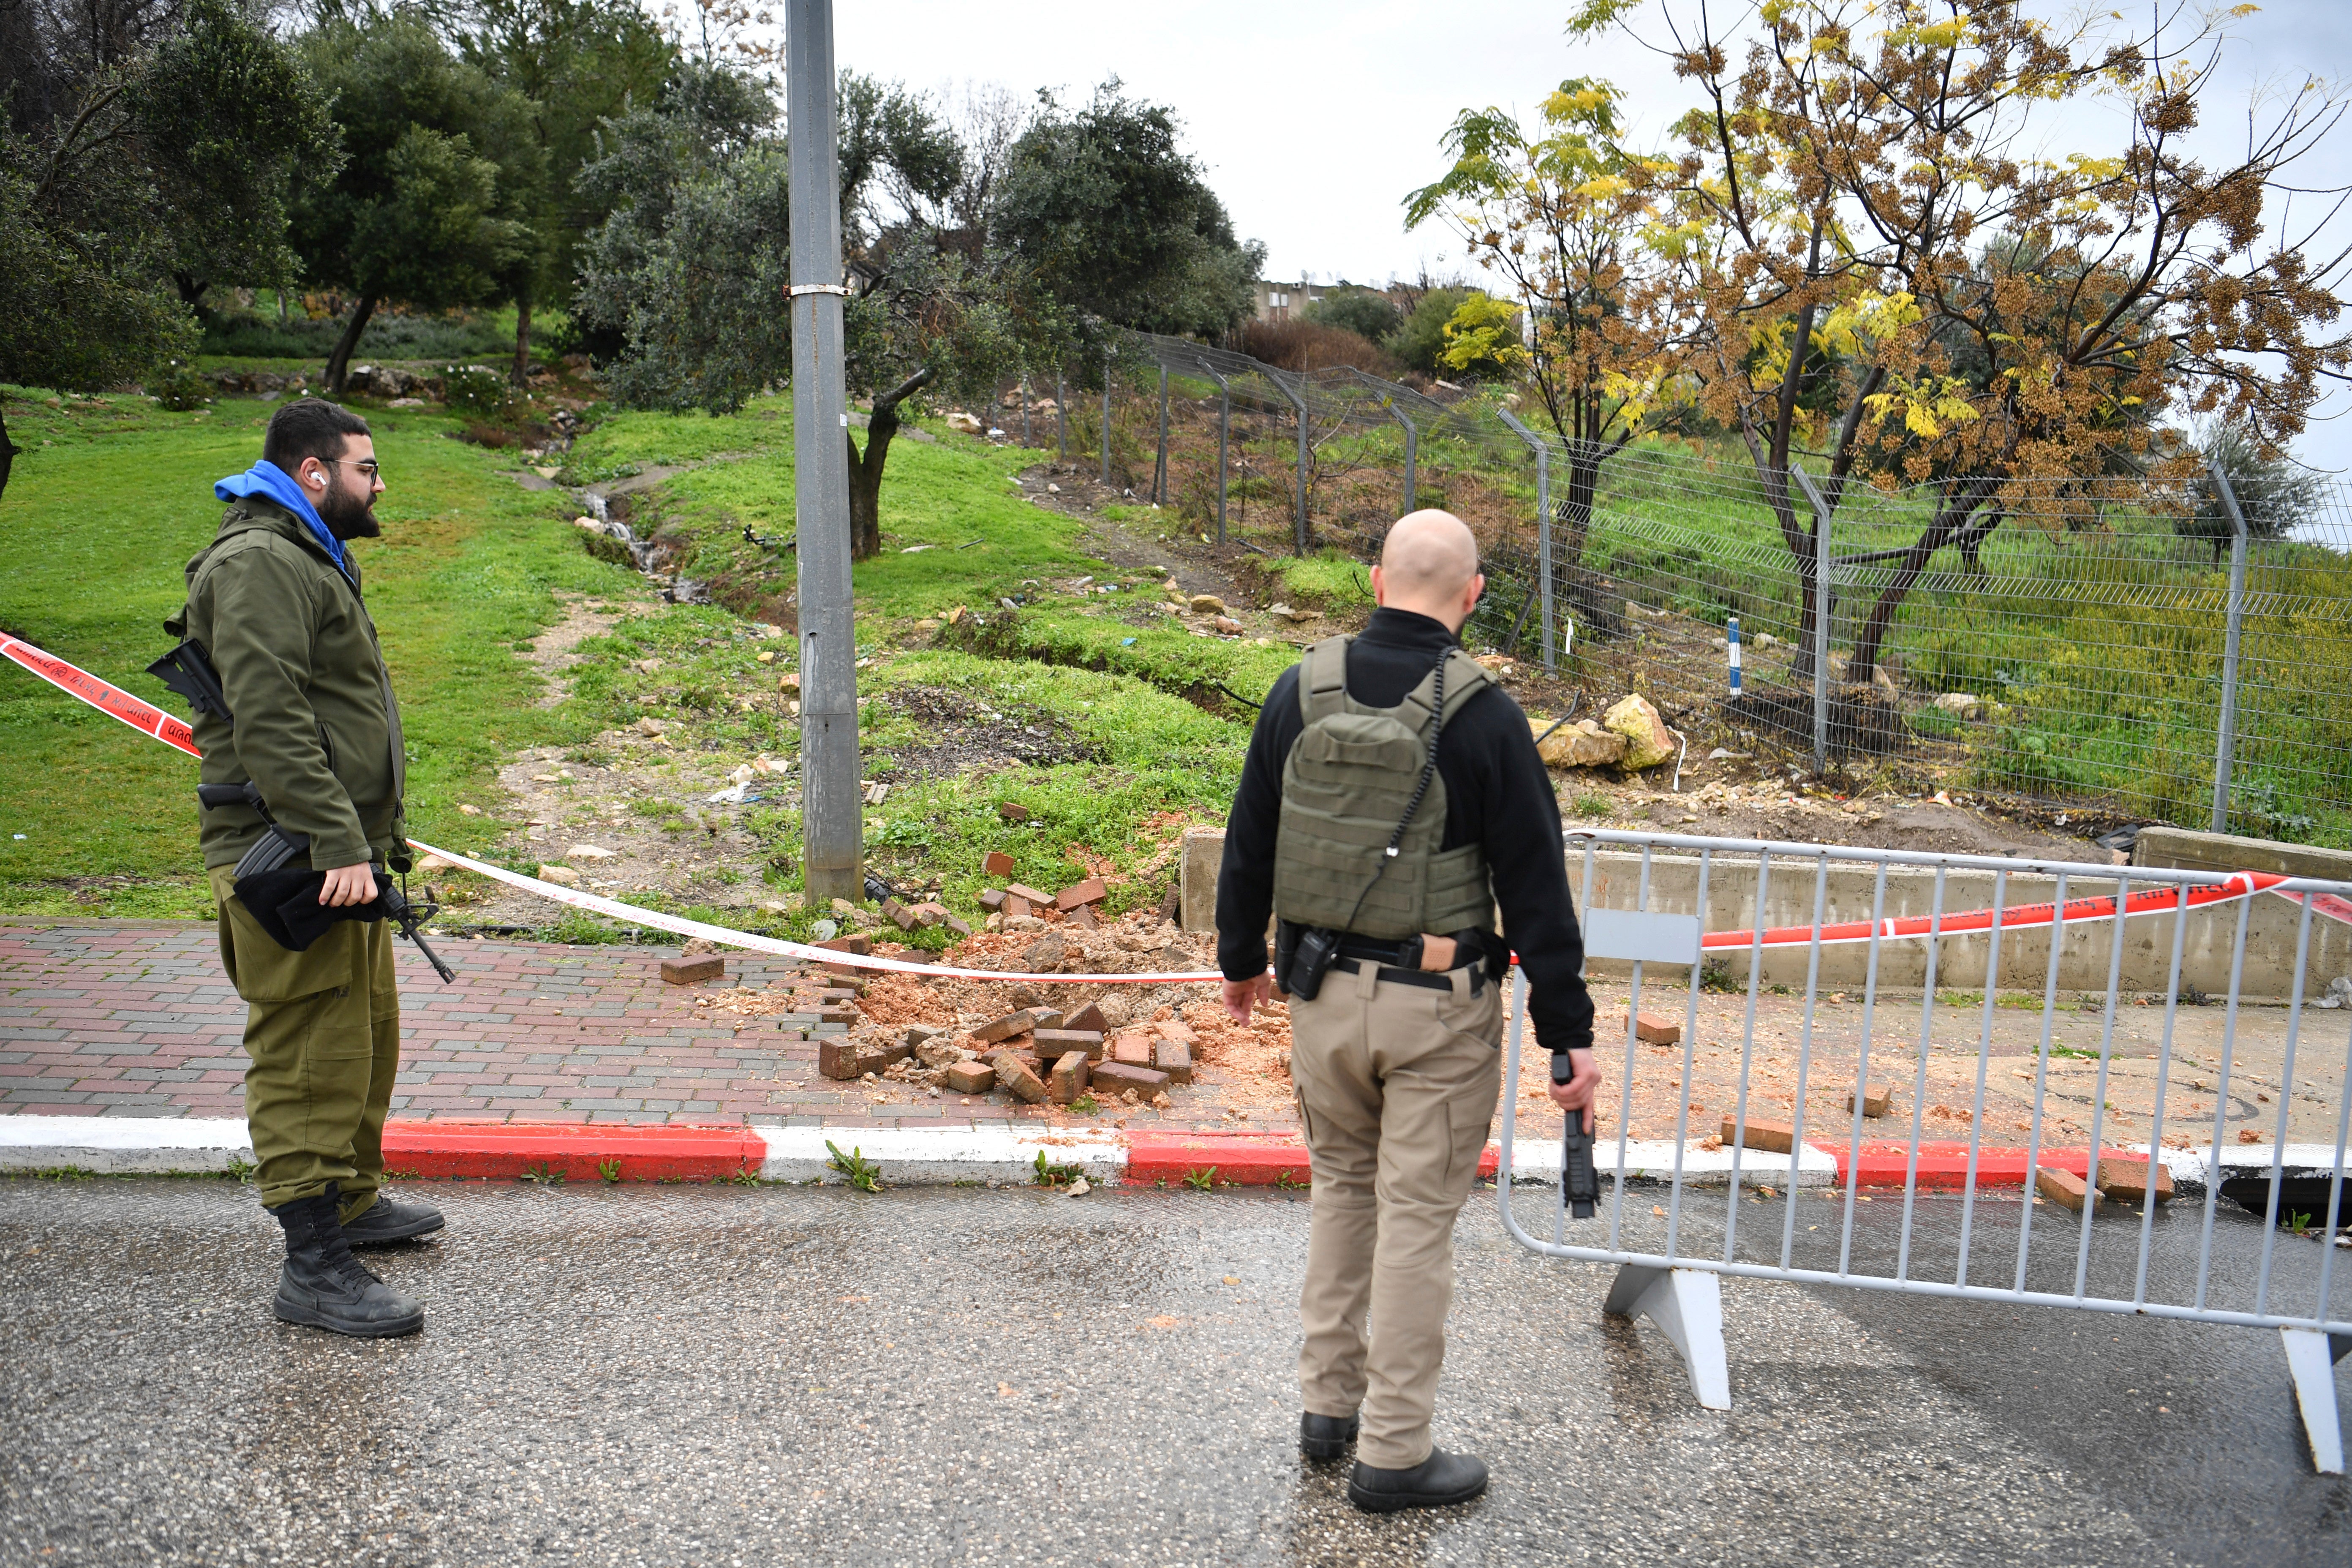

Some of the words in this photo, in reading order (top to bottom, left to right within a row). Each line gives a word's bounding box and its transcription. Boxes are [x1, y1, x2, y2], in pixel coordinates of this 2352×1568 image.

[112, 697, 128, 709] אין
[127, 704, 151, 724] מעבר
[168, 725, 193, 746] משט
